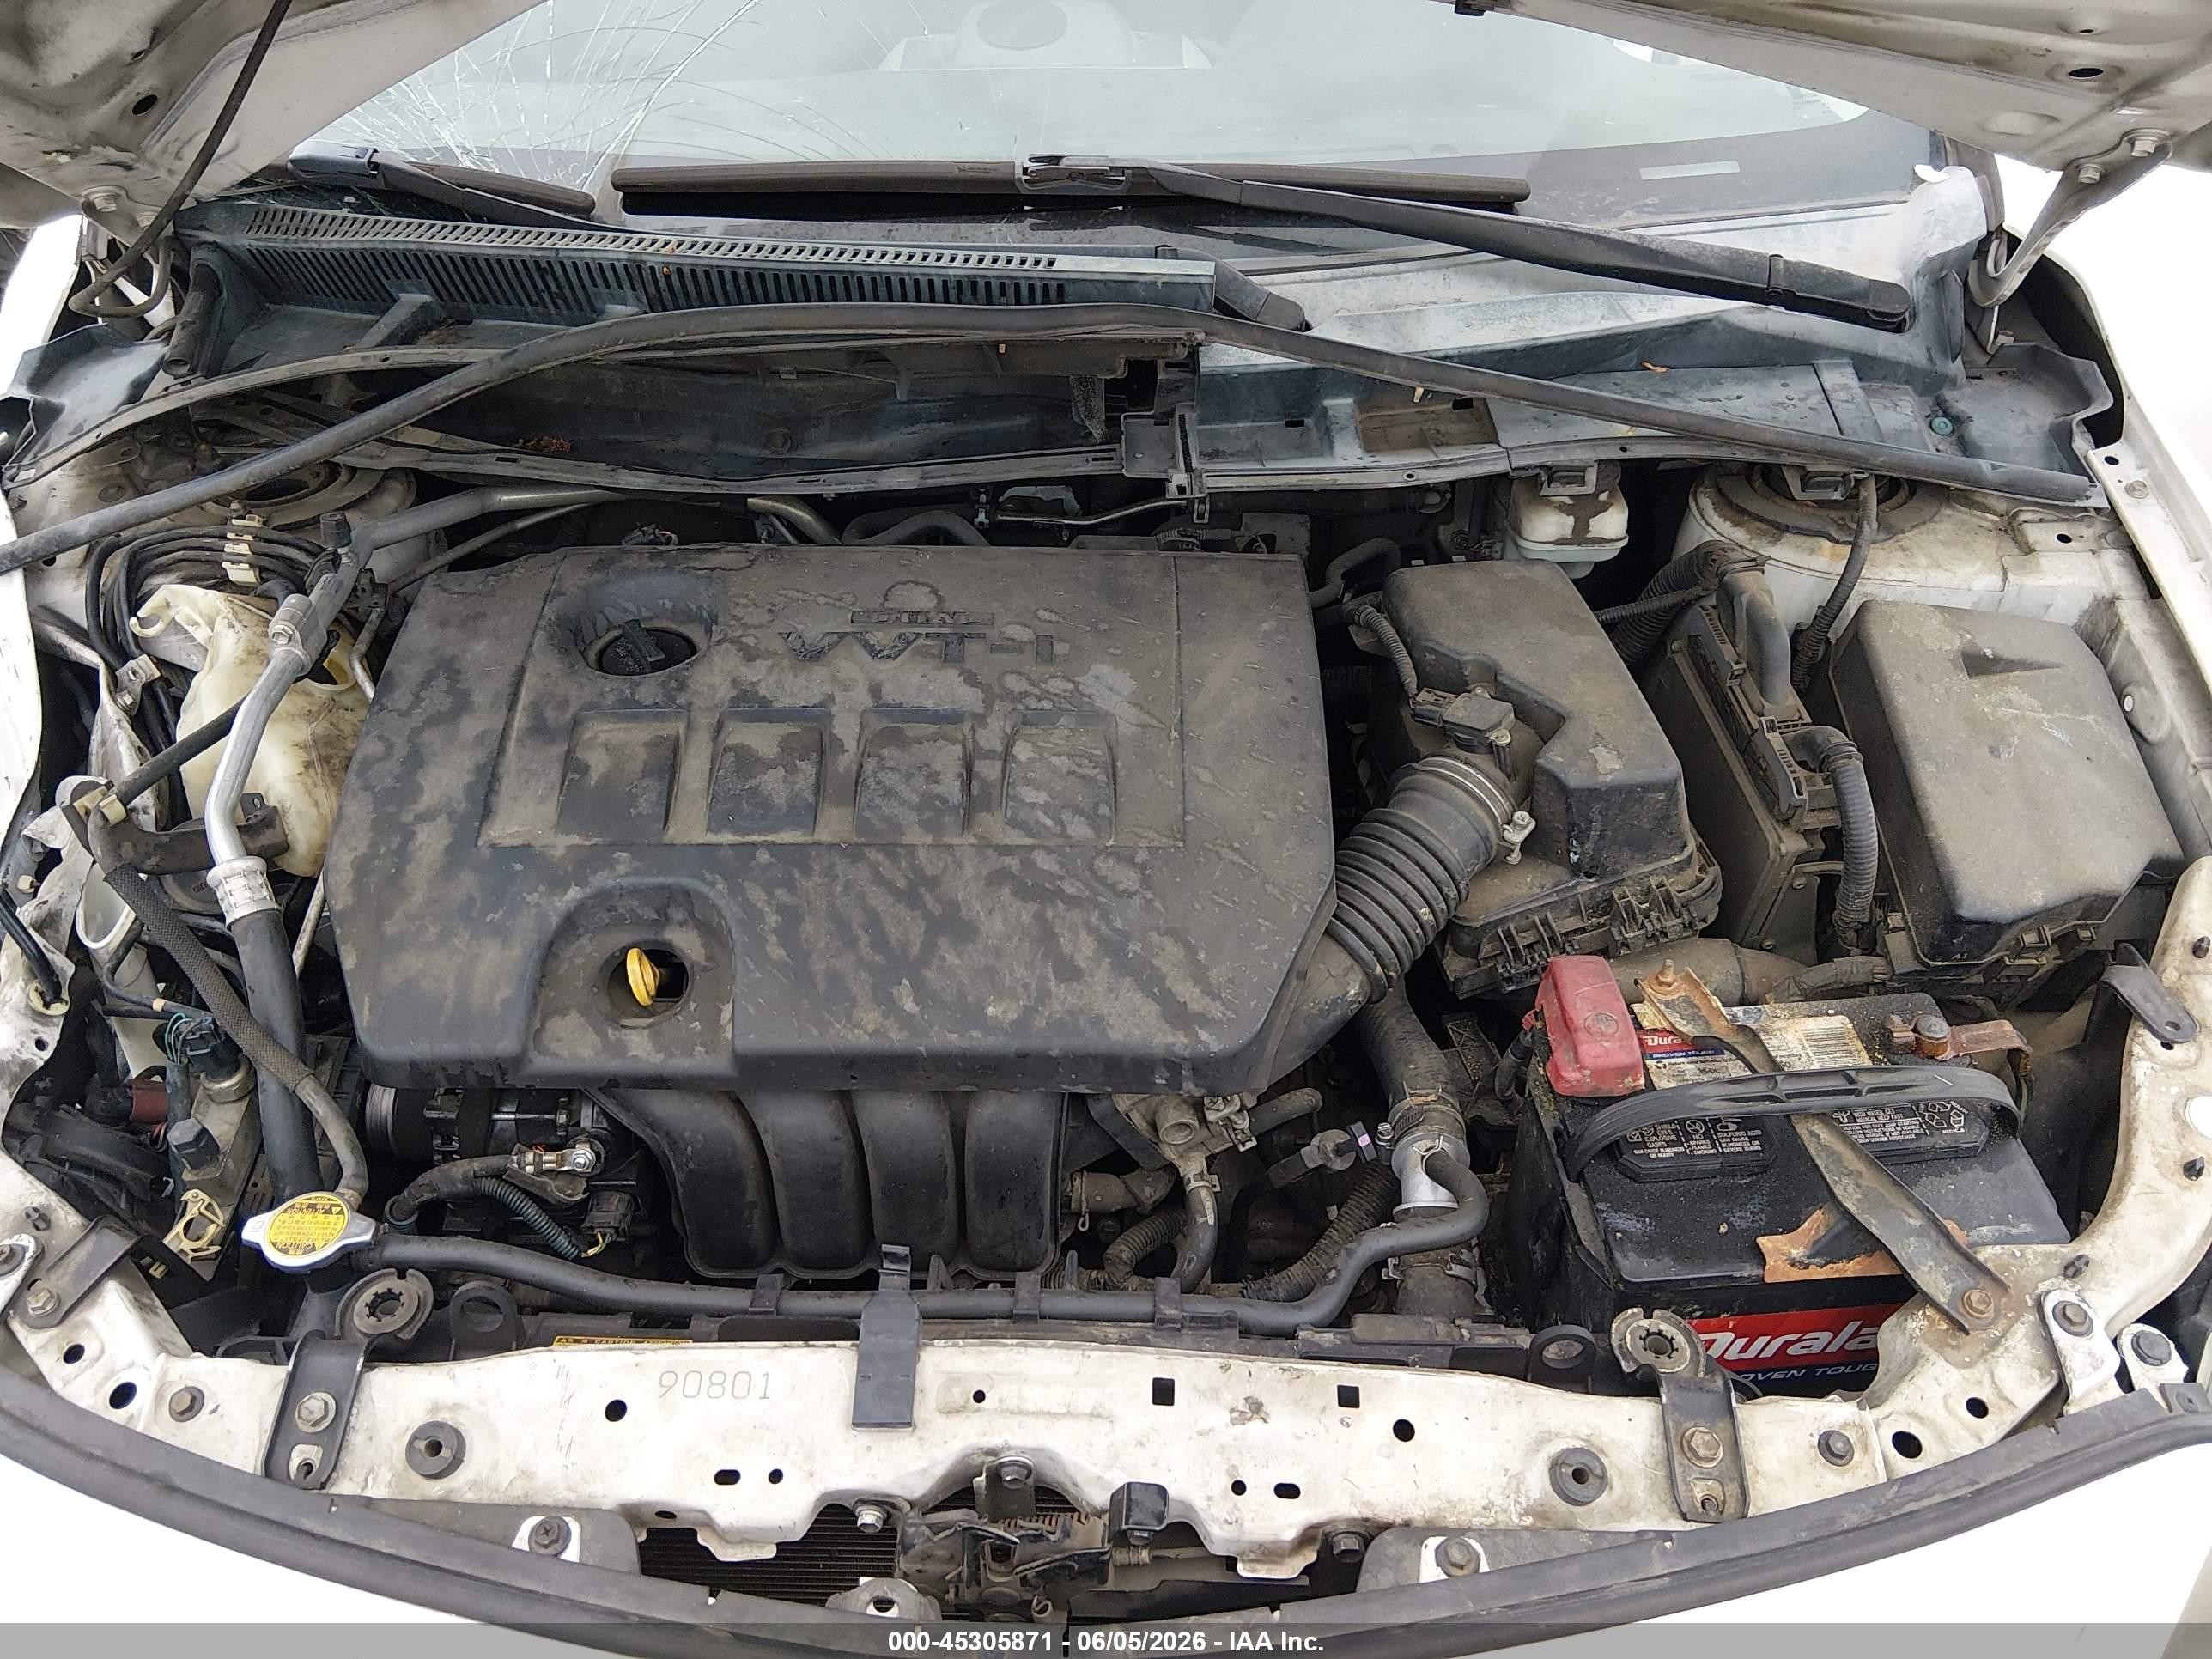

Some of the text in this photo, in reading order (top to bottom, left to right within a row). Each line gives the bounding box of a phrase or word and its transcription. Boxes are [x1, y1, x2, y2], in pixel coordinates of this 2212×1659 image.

[1643, 1036, 1683, 1046] Dura
[1814, 1363, 1879, 1376] TOUG
[659, 1370, 770, 1400] 90801
